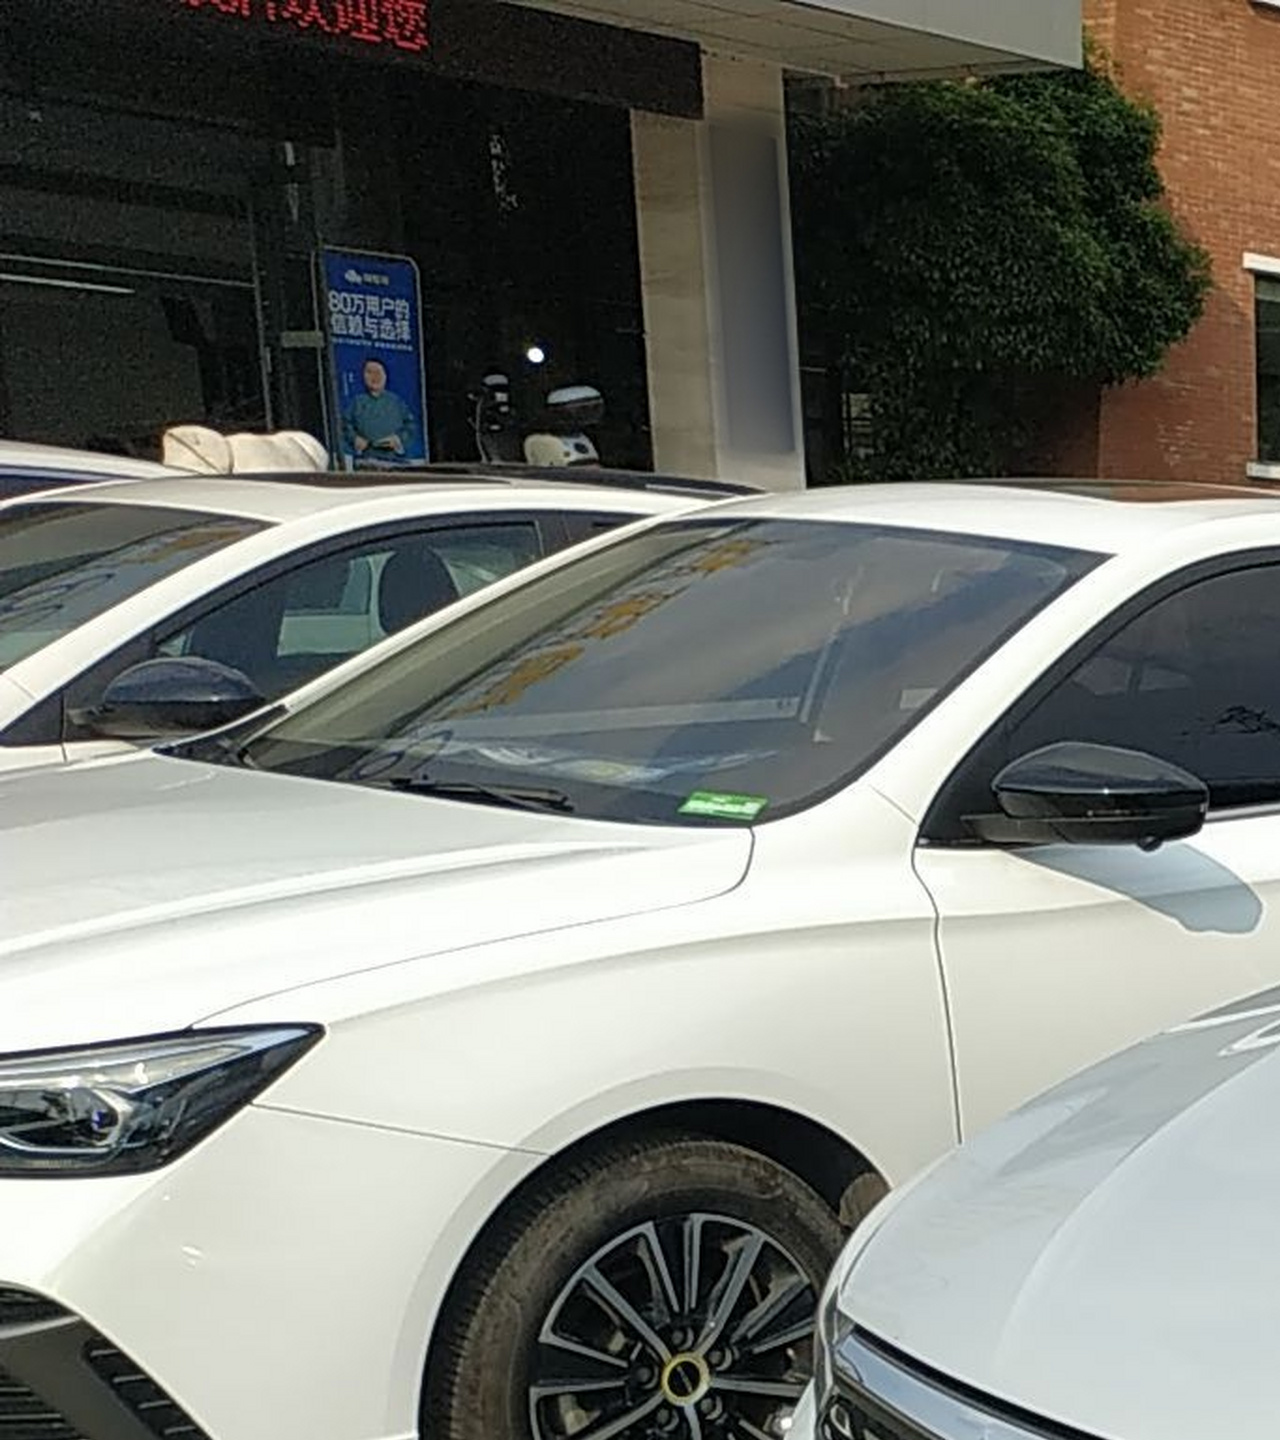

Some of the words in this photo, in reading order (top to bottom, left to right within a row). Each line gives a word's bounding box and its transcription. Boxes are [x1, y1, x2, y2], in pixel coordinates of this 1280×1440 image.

[328, 290, 410, 320] 80万用户的
[330, 313, 412, 342] 信赖与选择
